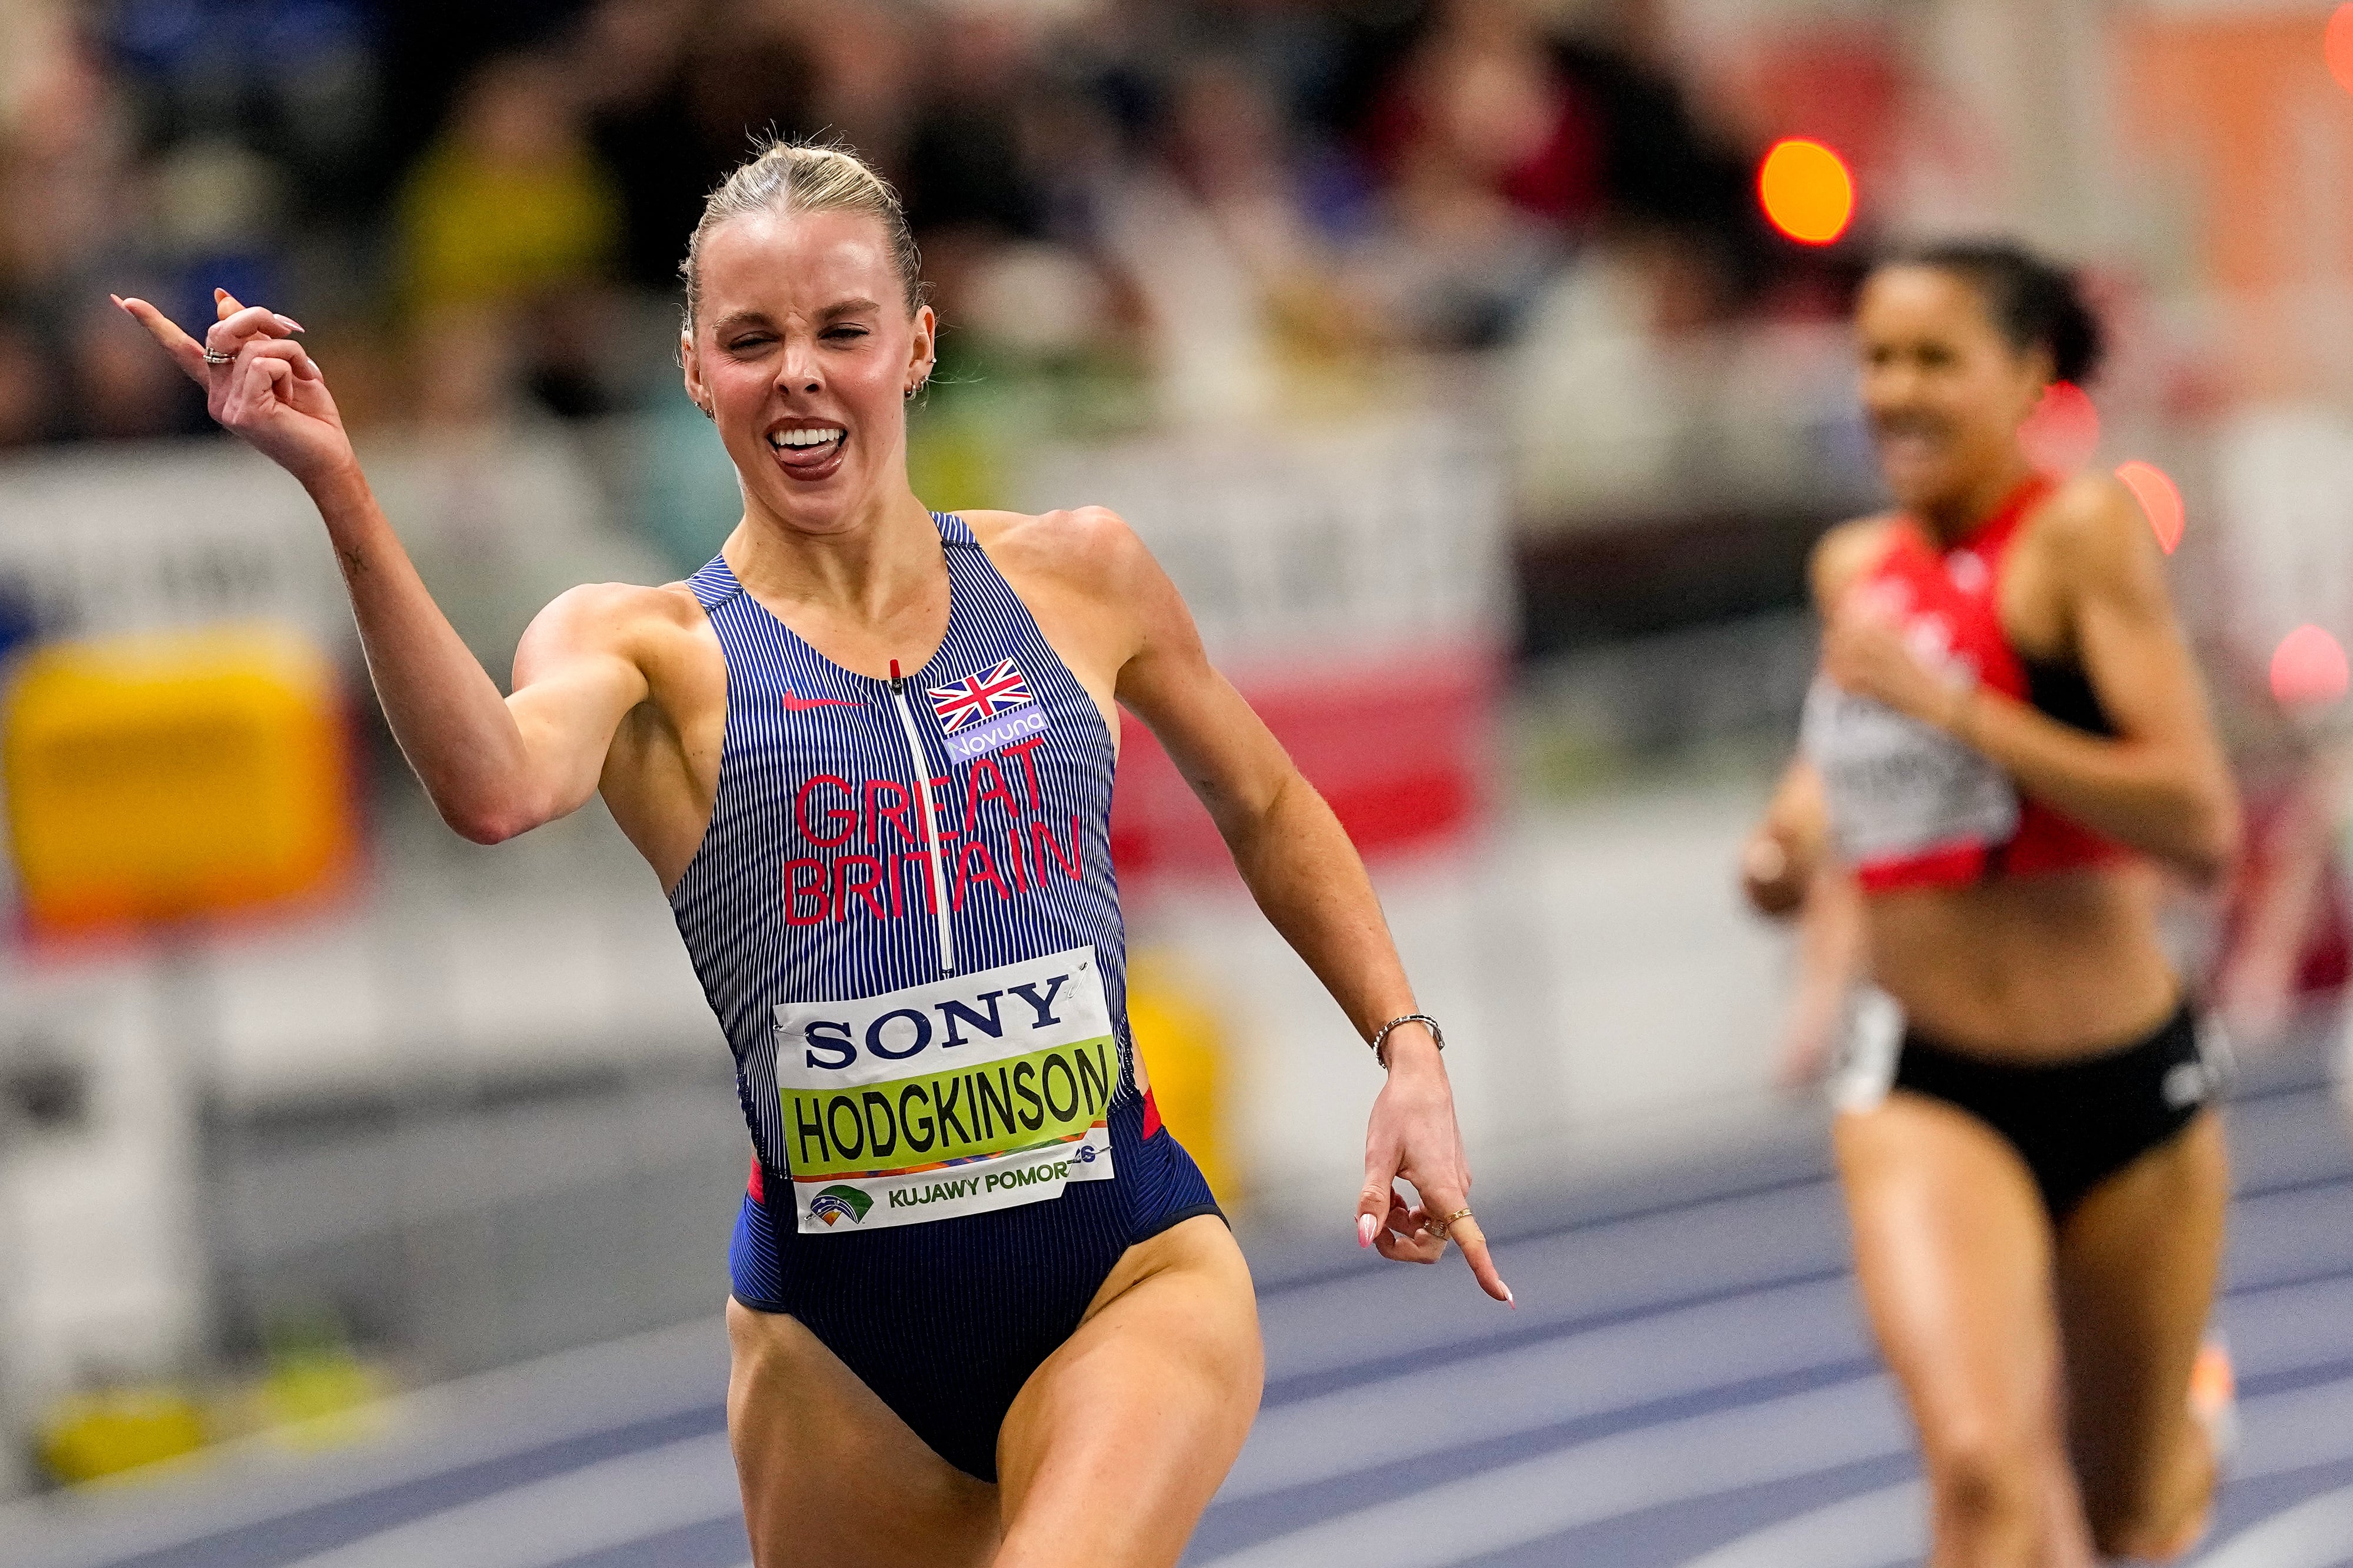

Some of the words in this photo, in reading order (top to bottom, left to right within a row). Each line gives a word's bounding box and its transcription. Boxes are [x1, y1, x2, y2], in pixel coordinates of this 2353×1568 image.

[947, 712, 1045, 761] Novuna
[795, 737, 1044, 848] GREAT
[784, 815, 1081, 926] BRITAIN
[805, 975, 1069, 1069] SONY
[795, 1045, 1108, 1163] HODGKINSON
[889, 1177, 979, 1208] KUJAWY
[985, 1160, 1074, 1193] POMOR
